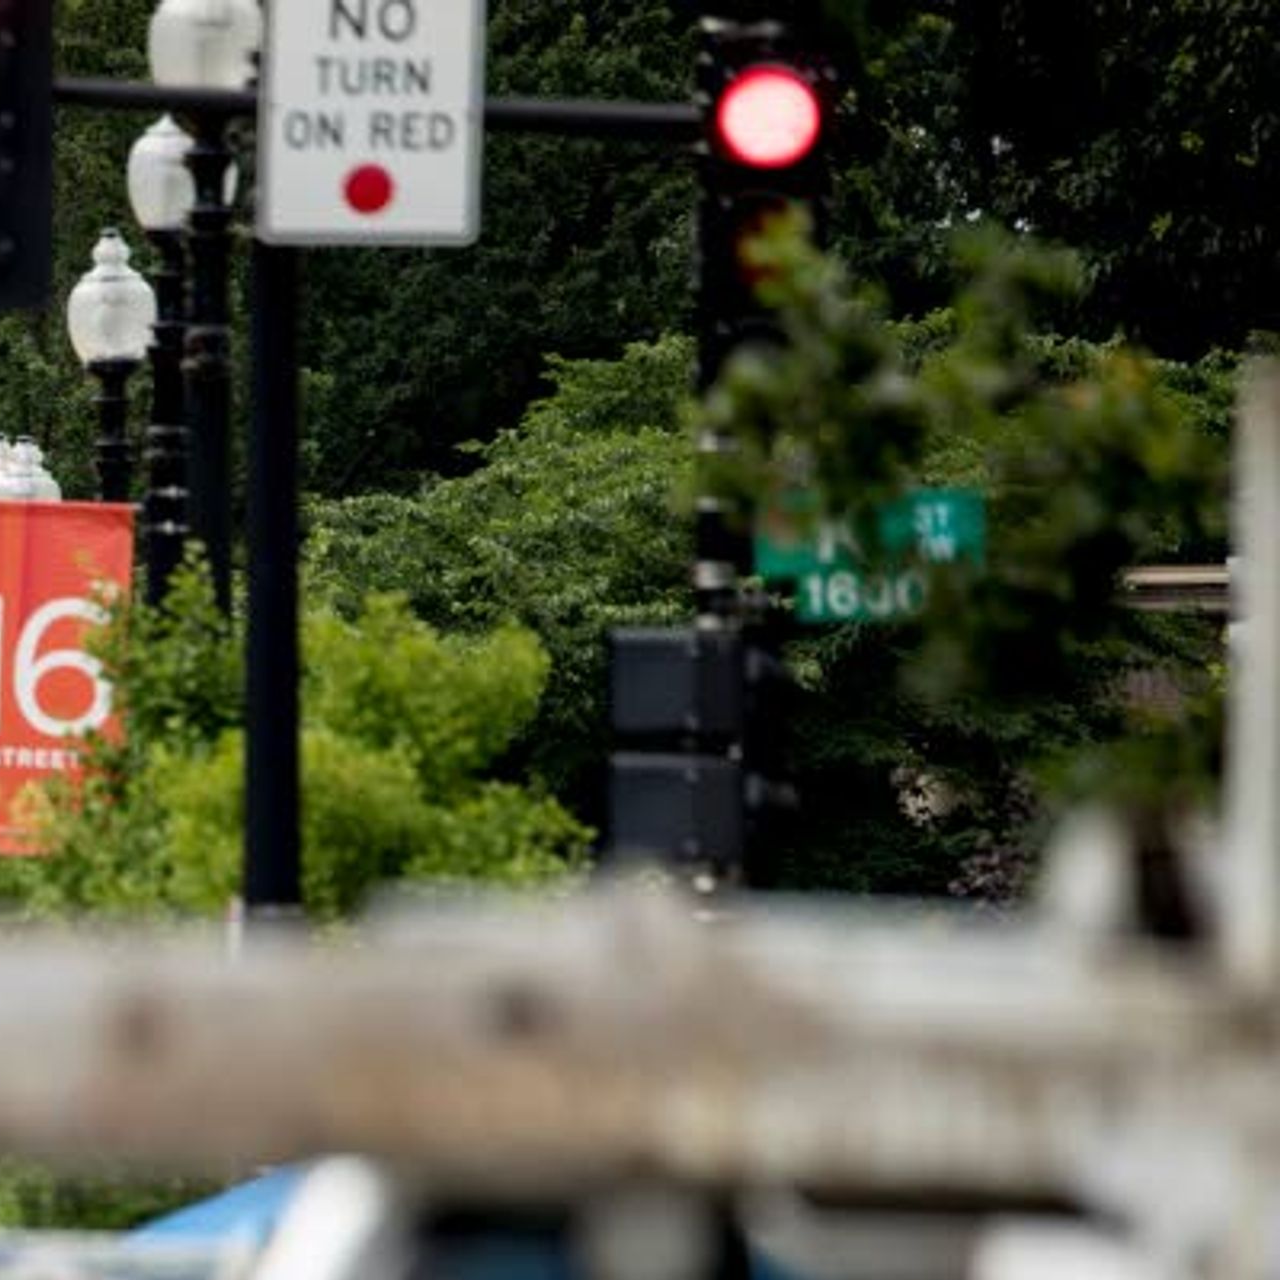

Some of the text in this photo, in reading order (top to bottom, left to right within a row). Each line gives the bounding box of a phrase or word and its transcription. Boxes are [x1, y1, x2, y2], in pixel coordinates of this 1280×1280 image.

[329, 0, 416, 41] NO
[315, 57, 430, 96] TURN
[284, 110, 455, 149] ON RED
